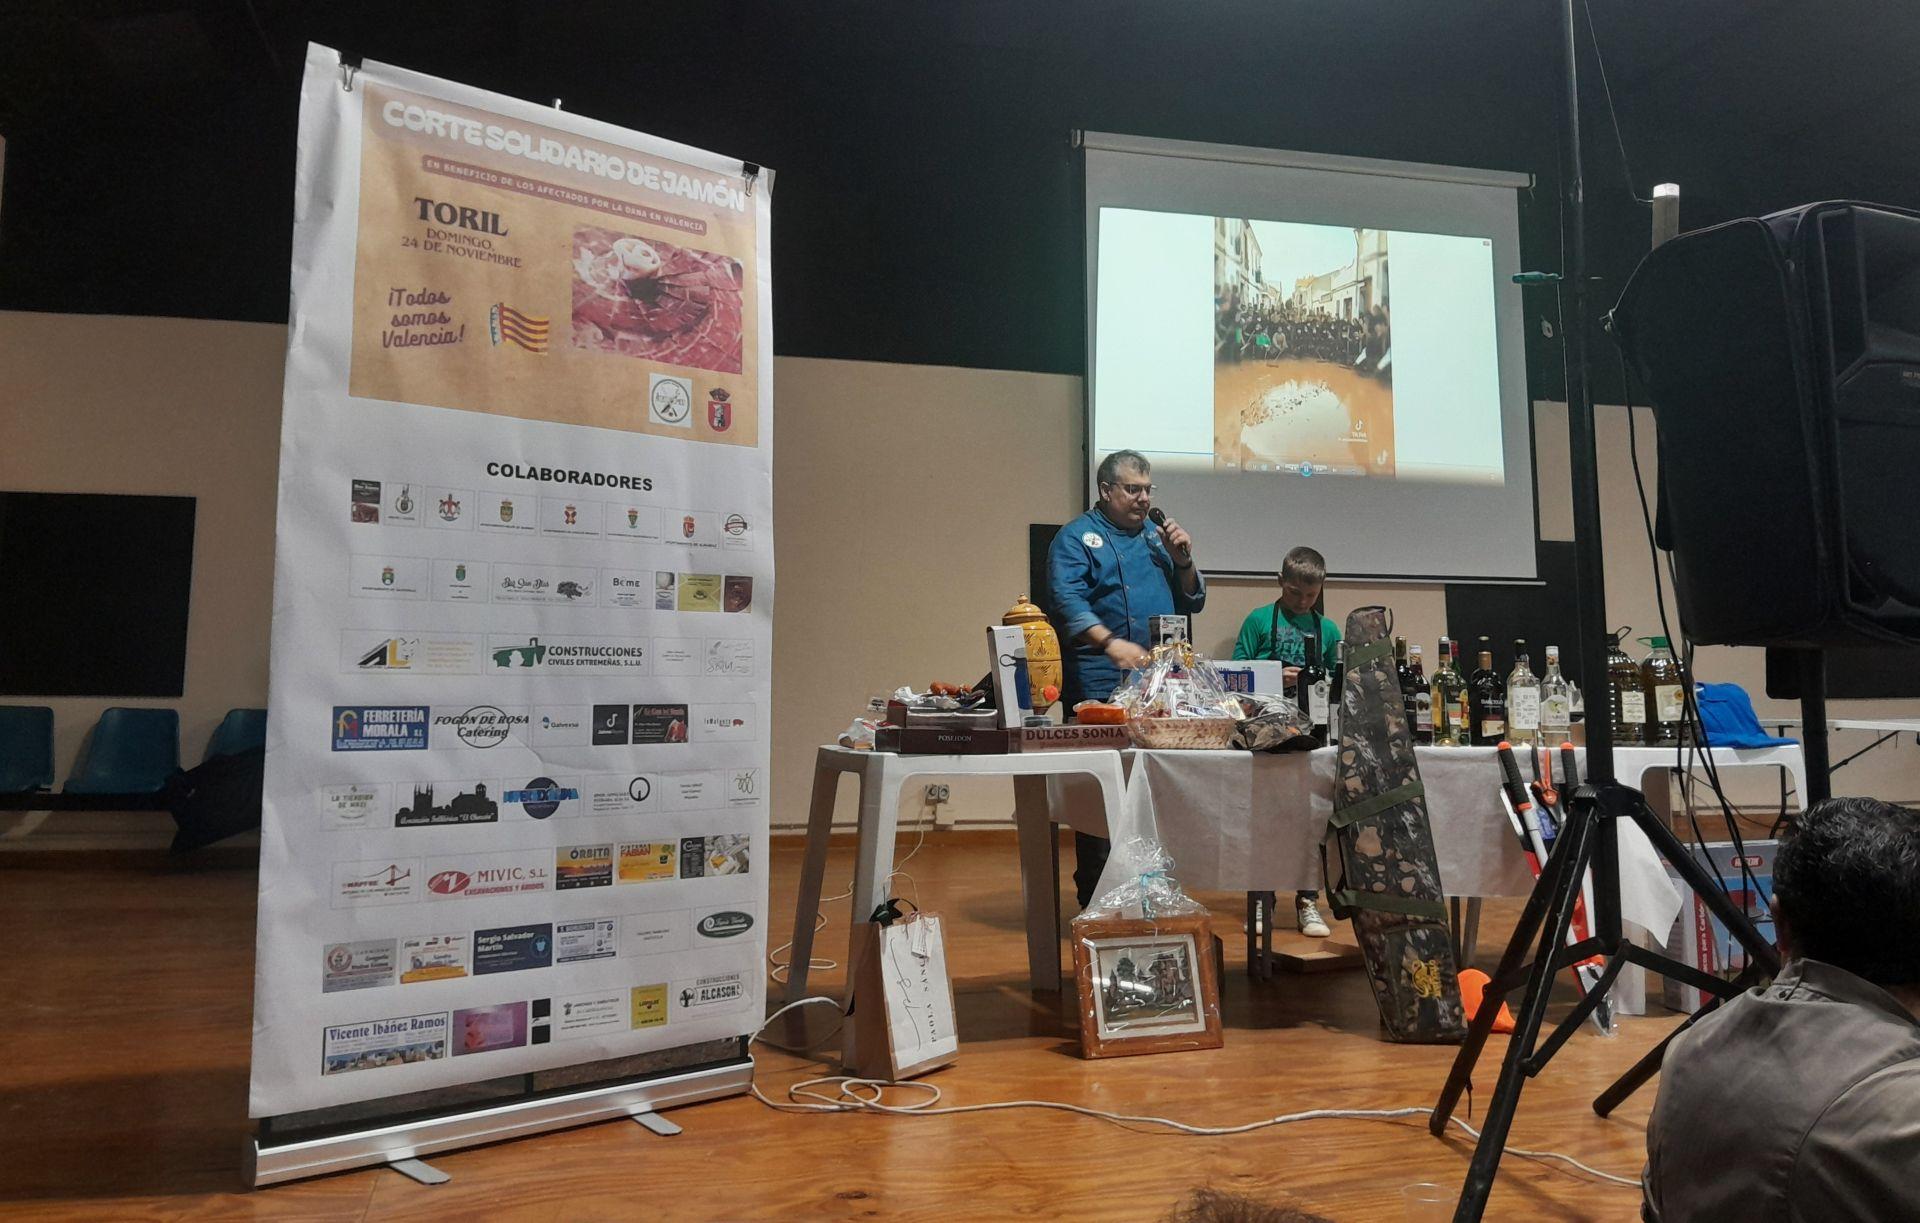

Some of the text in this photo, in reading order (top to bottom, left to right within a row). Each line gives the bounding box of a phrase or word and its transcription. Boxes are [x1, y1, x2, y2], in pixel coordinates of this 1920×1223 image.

[383, 100, 745, 212] CORTE SOLIDARIO DE JAMÓN
[427, 159, 704, 231] EN BENEFICIO DE LOS AFECTADOS POR LA DANA EN VALENCIA
[414, 197, 509, 237] TORIL
[401, 235, 523, 269] 24 DE NOVIEMBRE
[388, 287, 452, 307] ¡Todos
[390, 311, 452, 328] somos
[382, 323, 465, 349] Valencia!
[486, 462, 653, 491] COLABORADORES
[548, 645, 643, 657] CONSTRUCCIONES
[547, 658, 575, 666] CIVILES
[362, 708, 425, 723] FERRETERÍA
[479, 715, 497, 725] DE
[497, 715, 529, 724] ROSA
[362, 723, 408, 738] MORALA
[458, 727, 508, 740] Catering
[937, 734, 972, 742] POSEIDON
[1025, 726, 1125, 741] DULCES SONIA
[570, 846, 610, 860] ÓRBITA
[347, 880, 379, 888] MAPFRE
[502, 931, 535, 941] Salvador
[330, 1017, 445, 1040] Vicente Ibáñez Ramos
